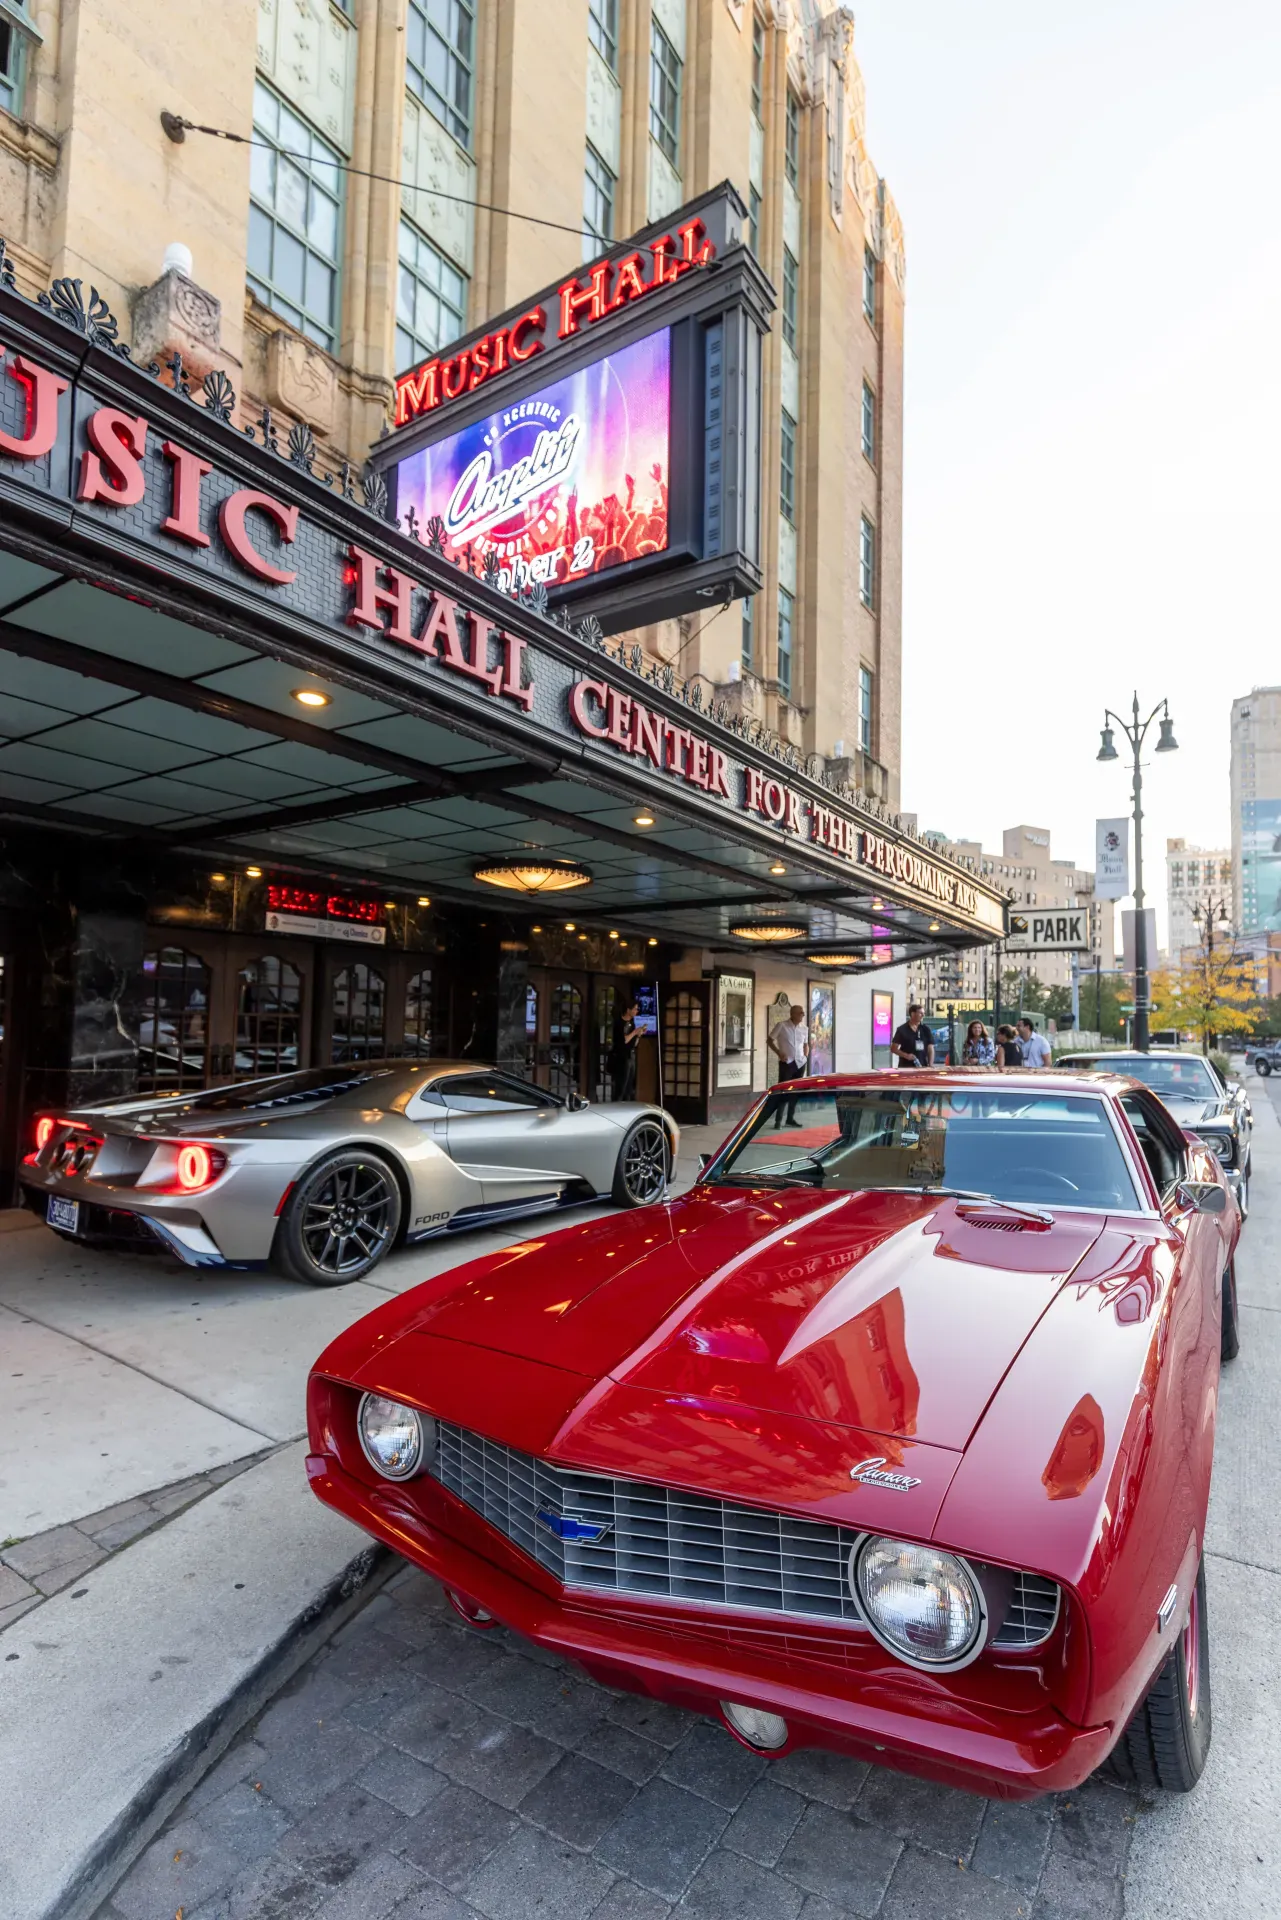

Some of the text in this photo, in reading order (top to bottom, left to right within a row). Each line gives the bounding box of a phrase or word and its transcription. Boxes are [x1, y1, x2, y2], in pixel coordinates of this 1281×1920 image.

[395, 217, 715, 427] MUSIC HALL
[503, 401, 561, 427] XCENTRIC
[0, 346, 299, 585] USIC
[346, 545, 534, 712] HALL
[569, 679, 730, 799] CENTER
[744, 767, 800, 833] FOR
[811, 801, 856, 859] THE
[862, 832, 955, 902] PERFORMING
[1033, 916, 1082, 943] PARK
[415, 1211, 450, 1226] FORD
[850, 1457, 921, 1488] Camaro
